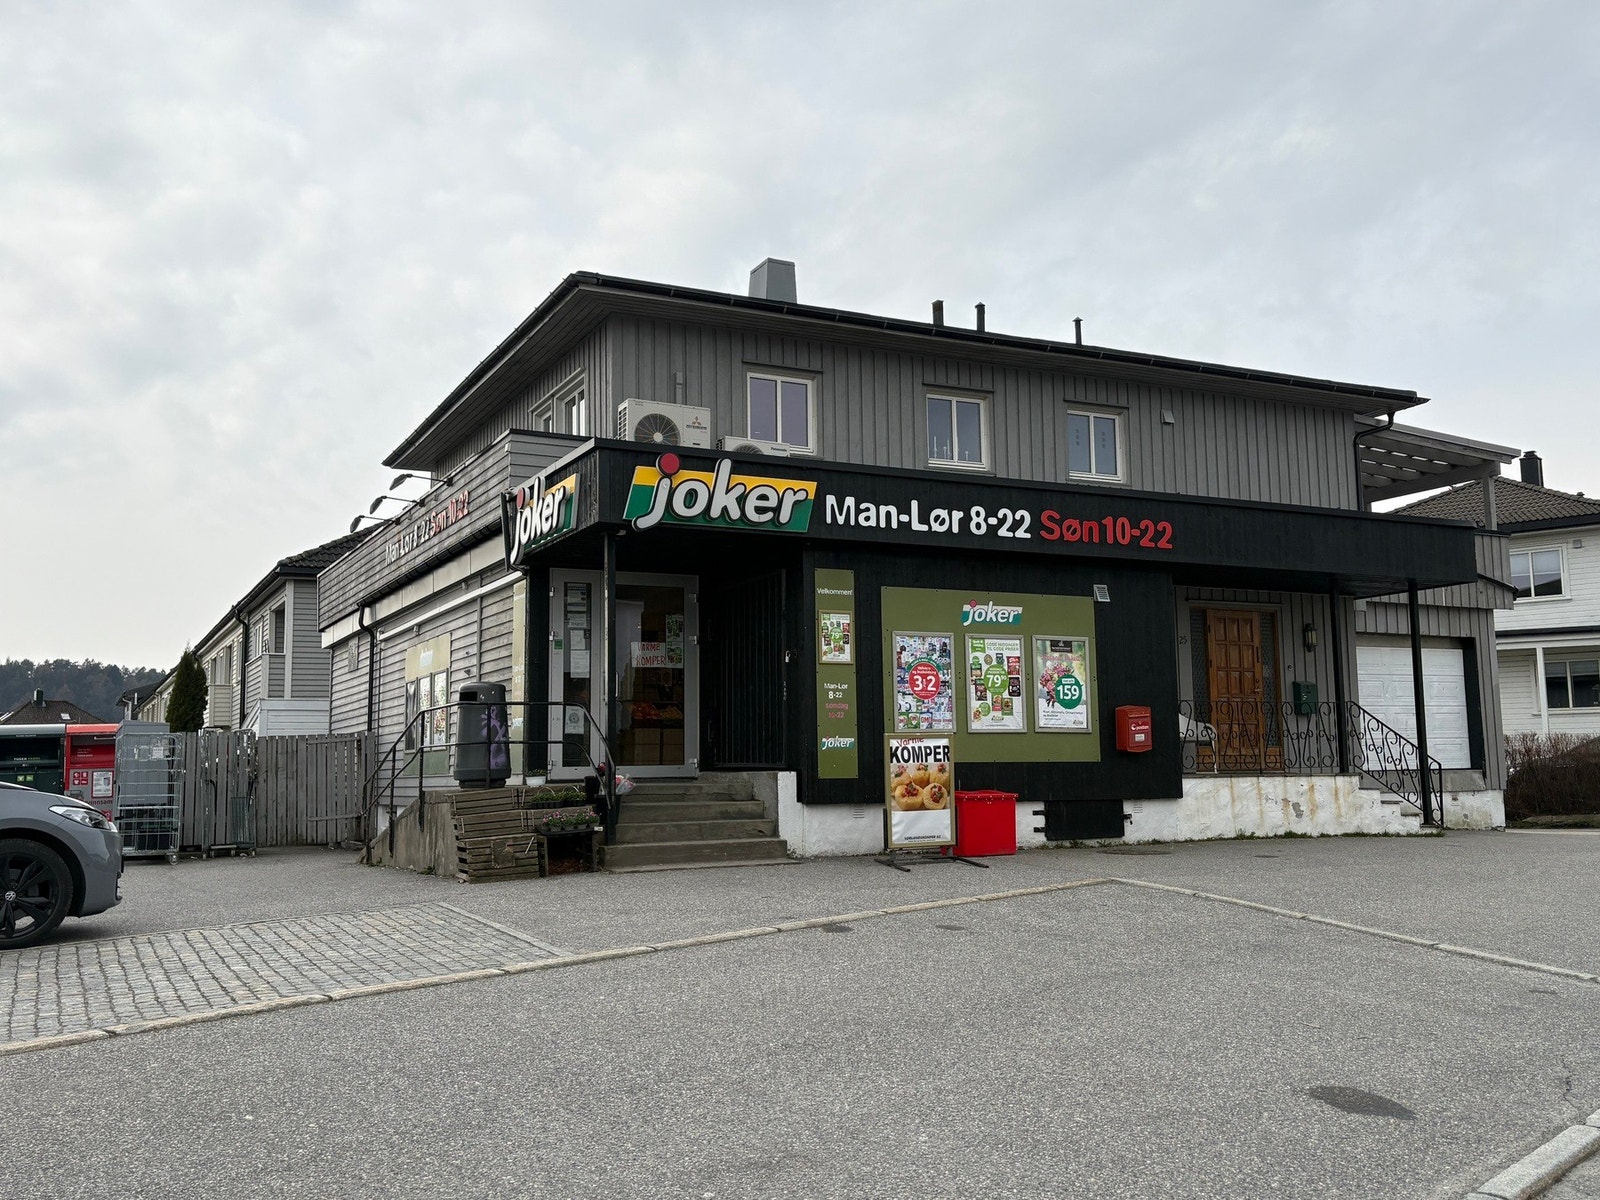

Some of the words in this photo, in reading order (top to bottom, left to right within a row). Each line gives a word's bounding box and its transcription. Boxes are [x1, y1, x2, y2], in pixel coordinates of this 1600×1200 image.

[631, 452, 809, 532] joker
[510, 476, 568, 565] joker
[825, 494, 964, 534] Man-Lør
[969, 505, 1032, 539] 8-22
[1040, 510, 1099, 544] Søn
[1101, 516, 1174, 549] 10-22
[963, 600, 1019, 626] joker
[913, 675, 923, 690] 3
[927, 675, 937, 690] 2
[986, 674, 1001, 687] 79
[1056, 685, 1080, 700] 159
[822, 736, 851, 750] joker
[890, 745, 950, 763] KOMPER
